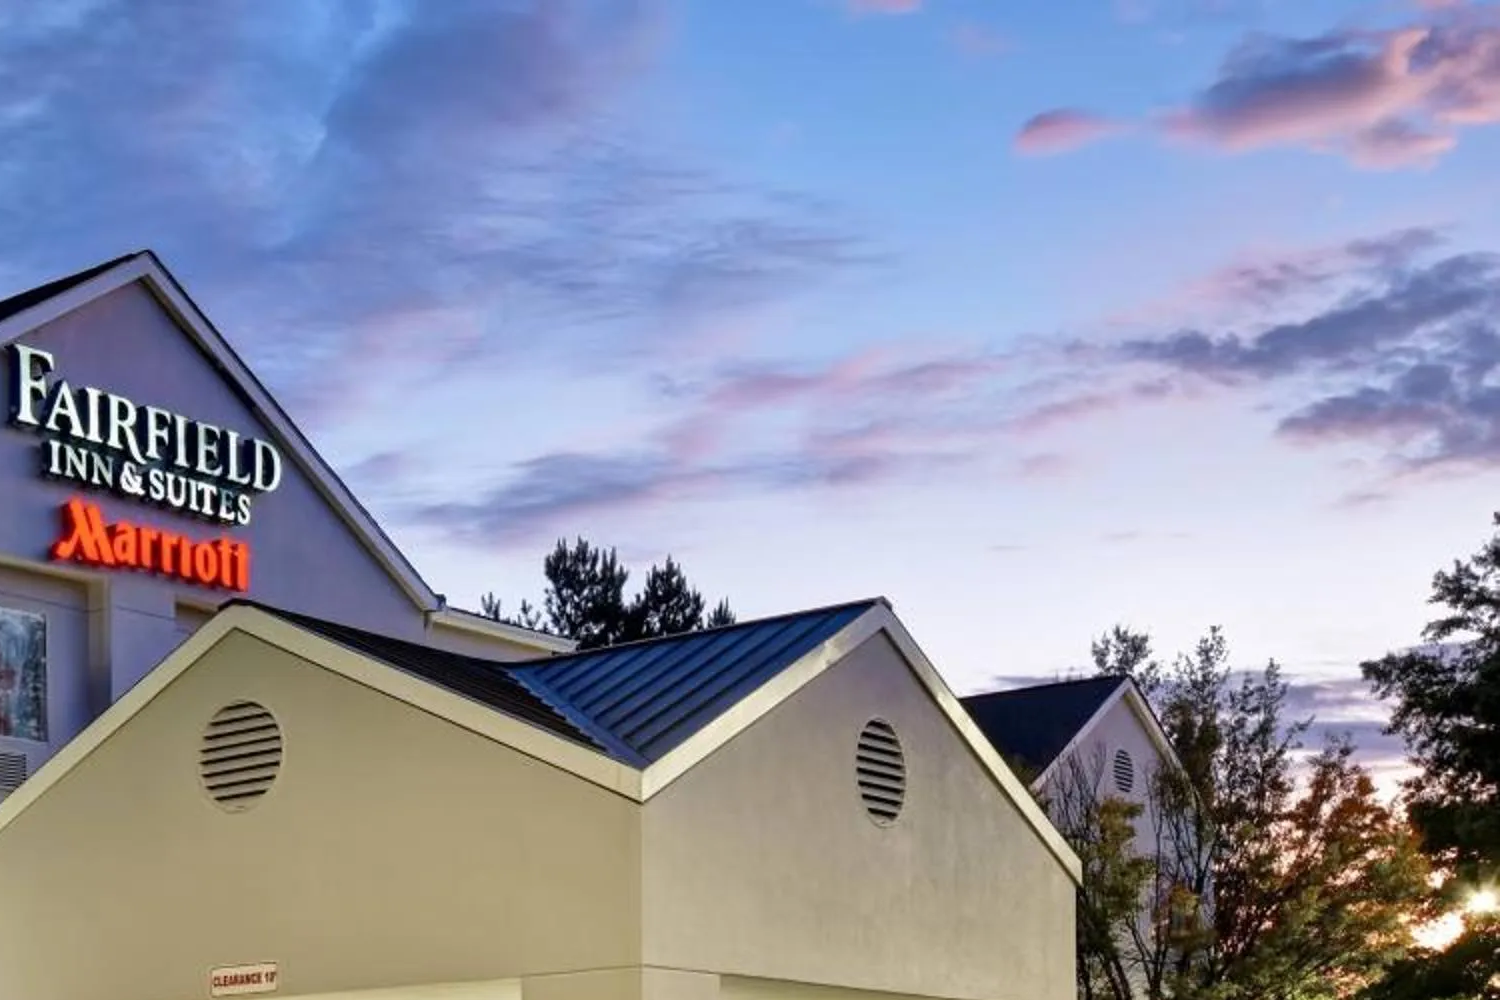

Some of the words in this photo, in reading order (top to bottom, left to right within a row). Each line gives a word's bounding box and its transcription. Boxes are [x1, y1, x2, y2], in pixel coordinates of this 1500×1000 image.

[14, 343, 283, 493] FAIRFIELD
[49, 439, 114, 488] INN
[119, 461, 146, 496] &
[149, 468, 252, 526] SUITES
[52, 497, 249, 592] Marriott
